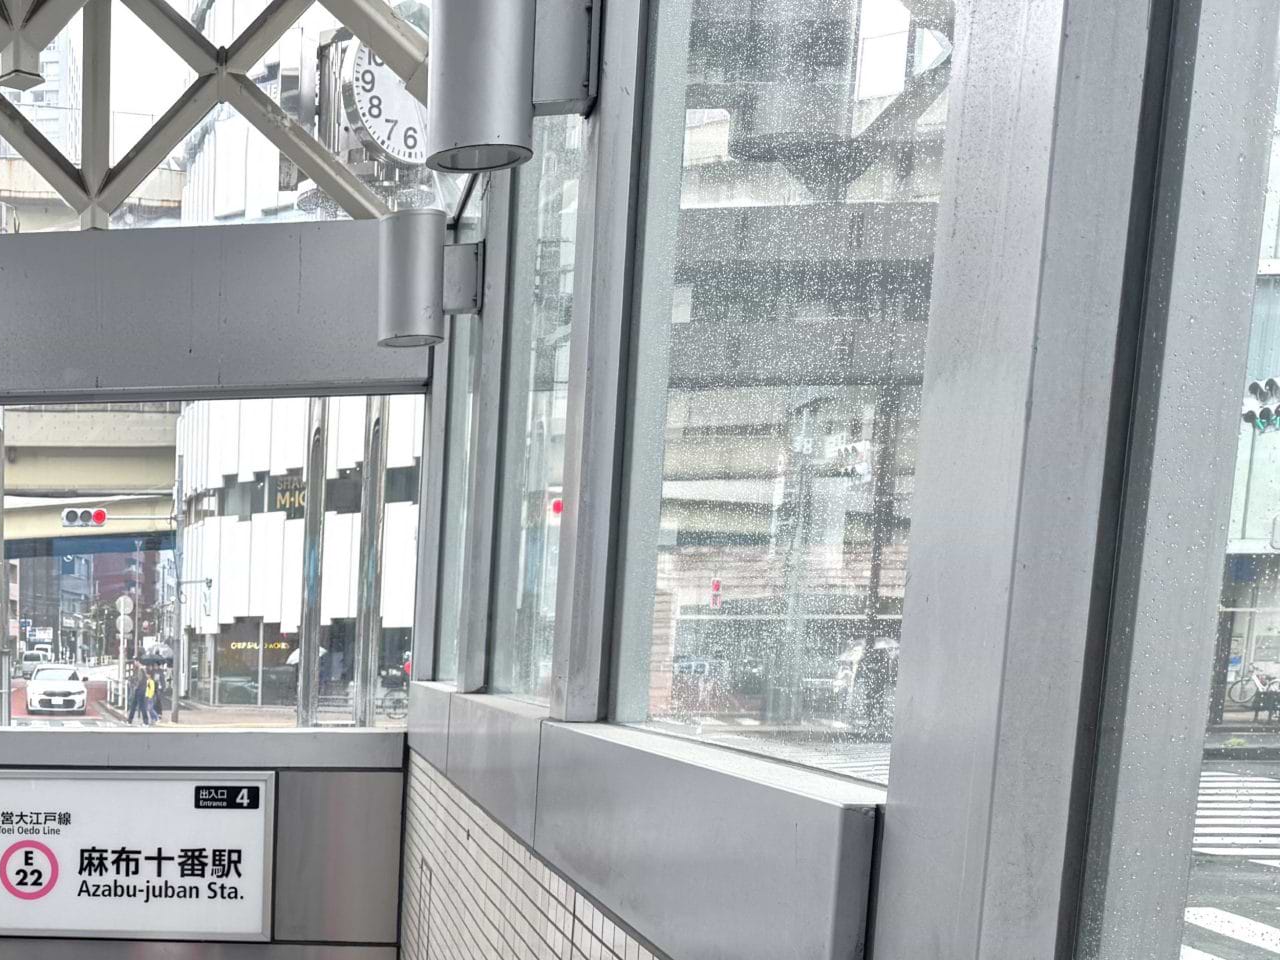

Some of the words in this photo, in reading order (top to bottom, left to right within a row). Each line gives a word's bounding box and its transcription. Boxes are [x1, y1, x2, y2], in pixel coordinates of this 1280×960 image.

[361, 69, 376, 93] 9
[368, 95, 382, 119] 8
[384, 118, 398, 141] 7
[403, 126, 418, 150] 6
[199, 789, 227, 799] 出入口
[235, 789, 250, 806] 4
[17, 826, 40, 835] Oedo
[43, 826, 61, 835] Line
[24, 851, 34, 866] E
[78, 847, 243, 879] 麻布十番駅
[15, 870, 43, 887] 22
[77, 880, 200, 903] Azabu-juban
[207, 881, 245, 900] Sta.
